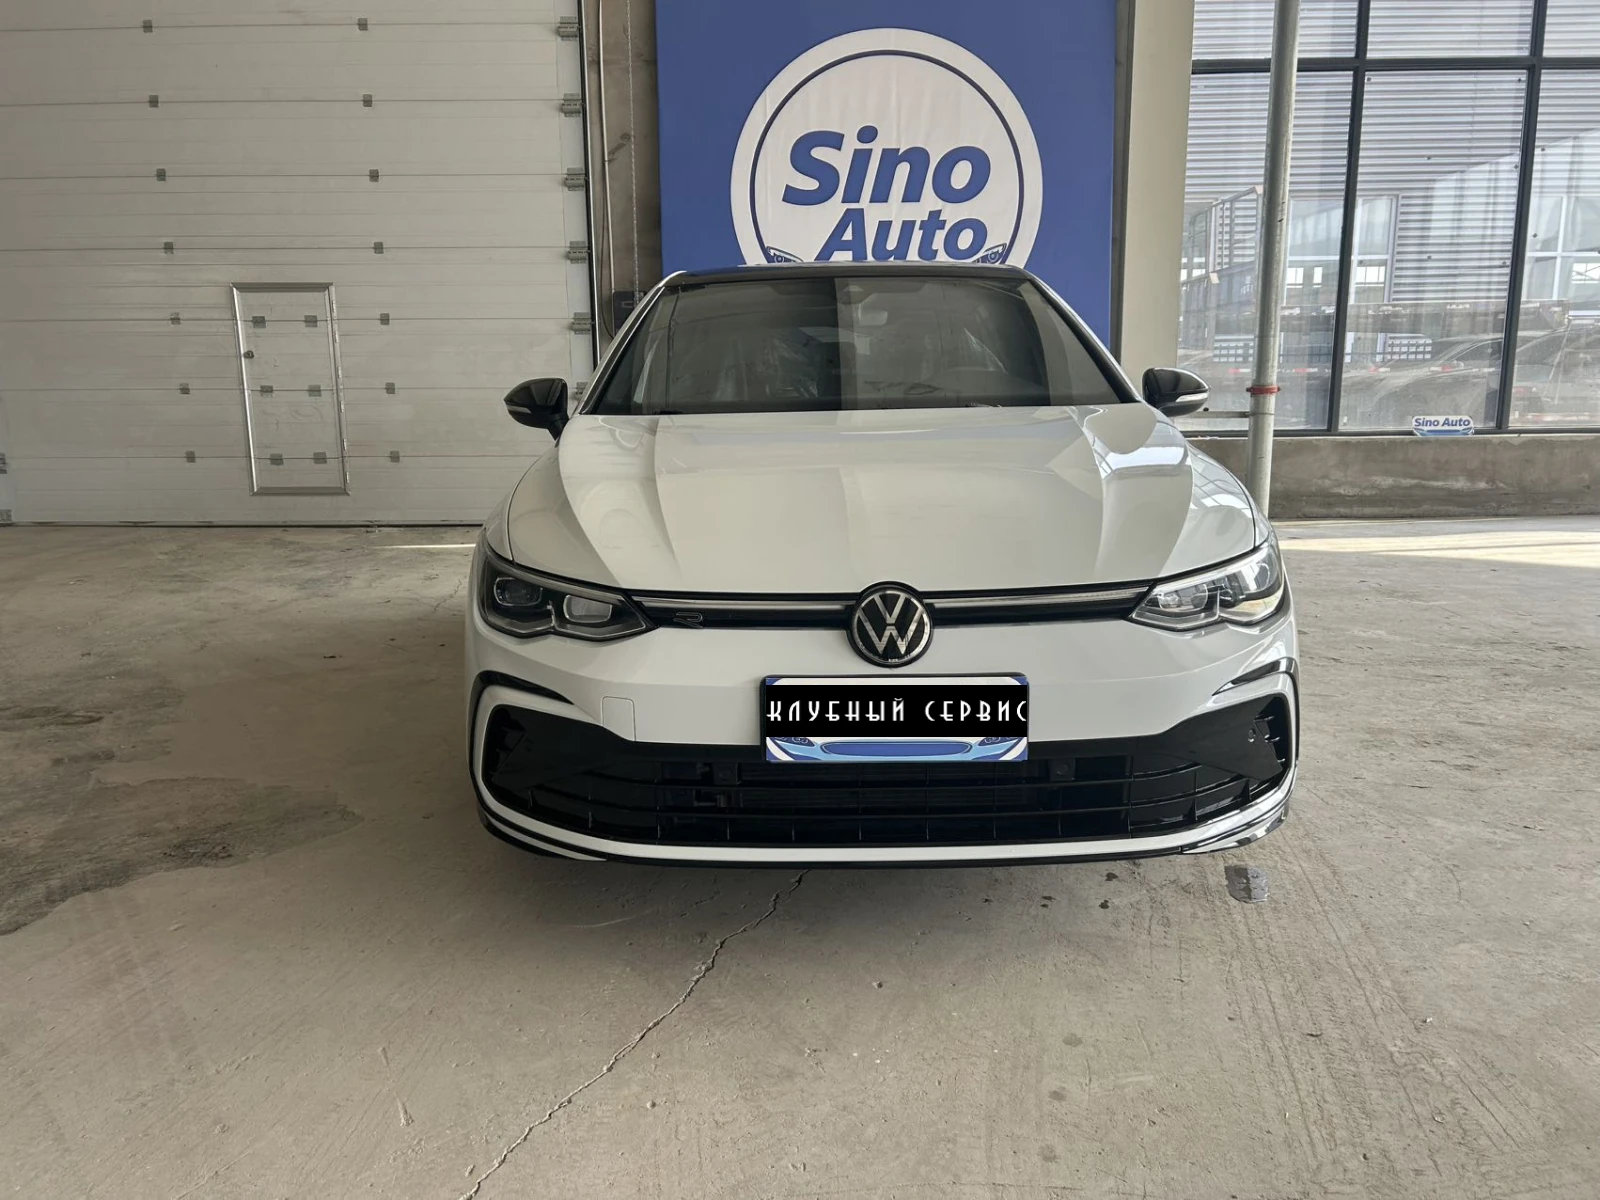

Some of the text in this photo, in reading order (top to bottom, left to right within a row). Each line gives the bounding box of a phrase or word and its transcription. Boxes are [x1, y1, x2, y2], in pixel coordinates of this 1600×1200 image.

[781, 125, 991, 206] Sino
[813, 207, 988, 262] Auto
[1414, 417, 1471, 427] Sino Auto
